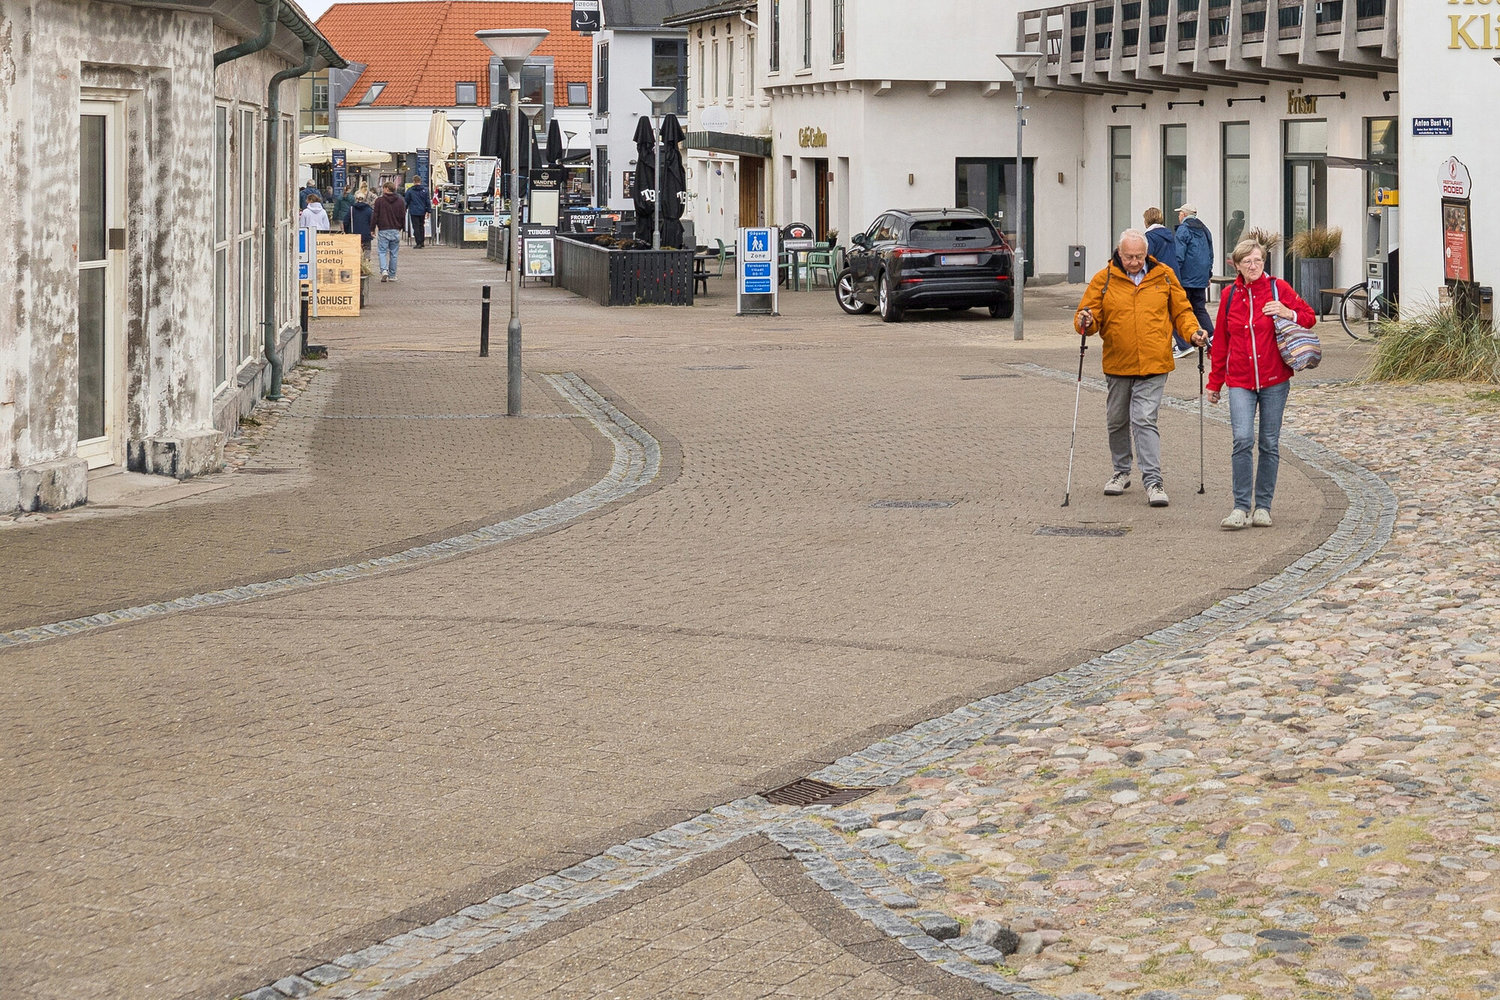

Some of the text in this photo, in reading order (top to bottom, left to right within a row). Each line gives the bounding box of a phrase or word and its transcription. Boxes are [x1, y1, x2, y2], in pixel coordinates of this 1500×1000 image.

[1414, 119, 1451, 128] Anton Bast Vej
[1443, 186, 1464, 195] RODEO
